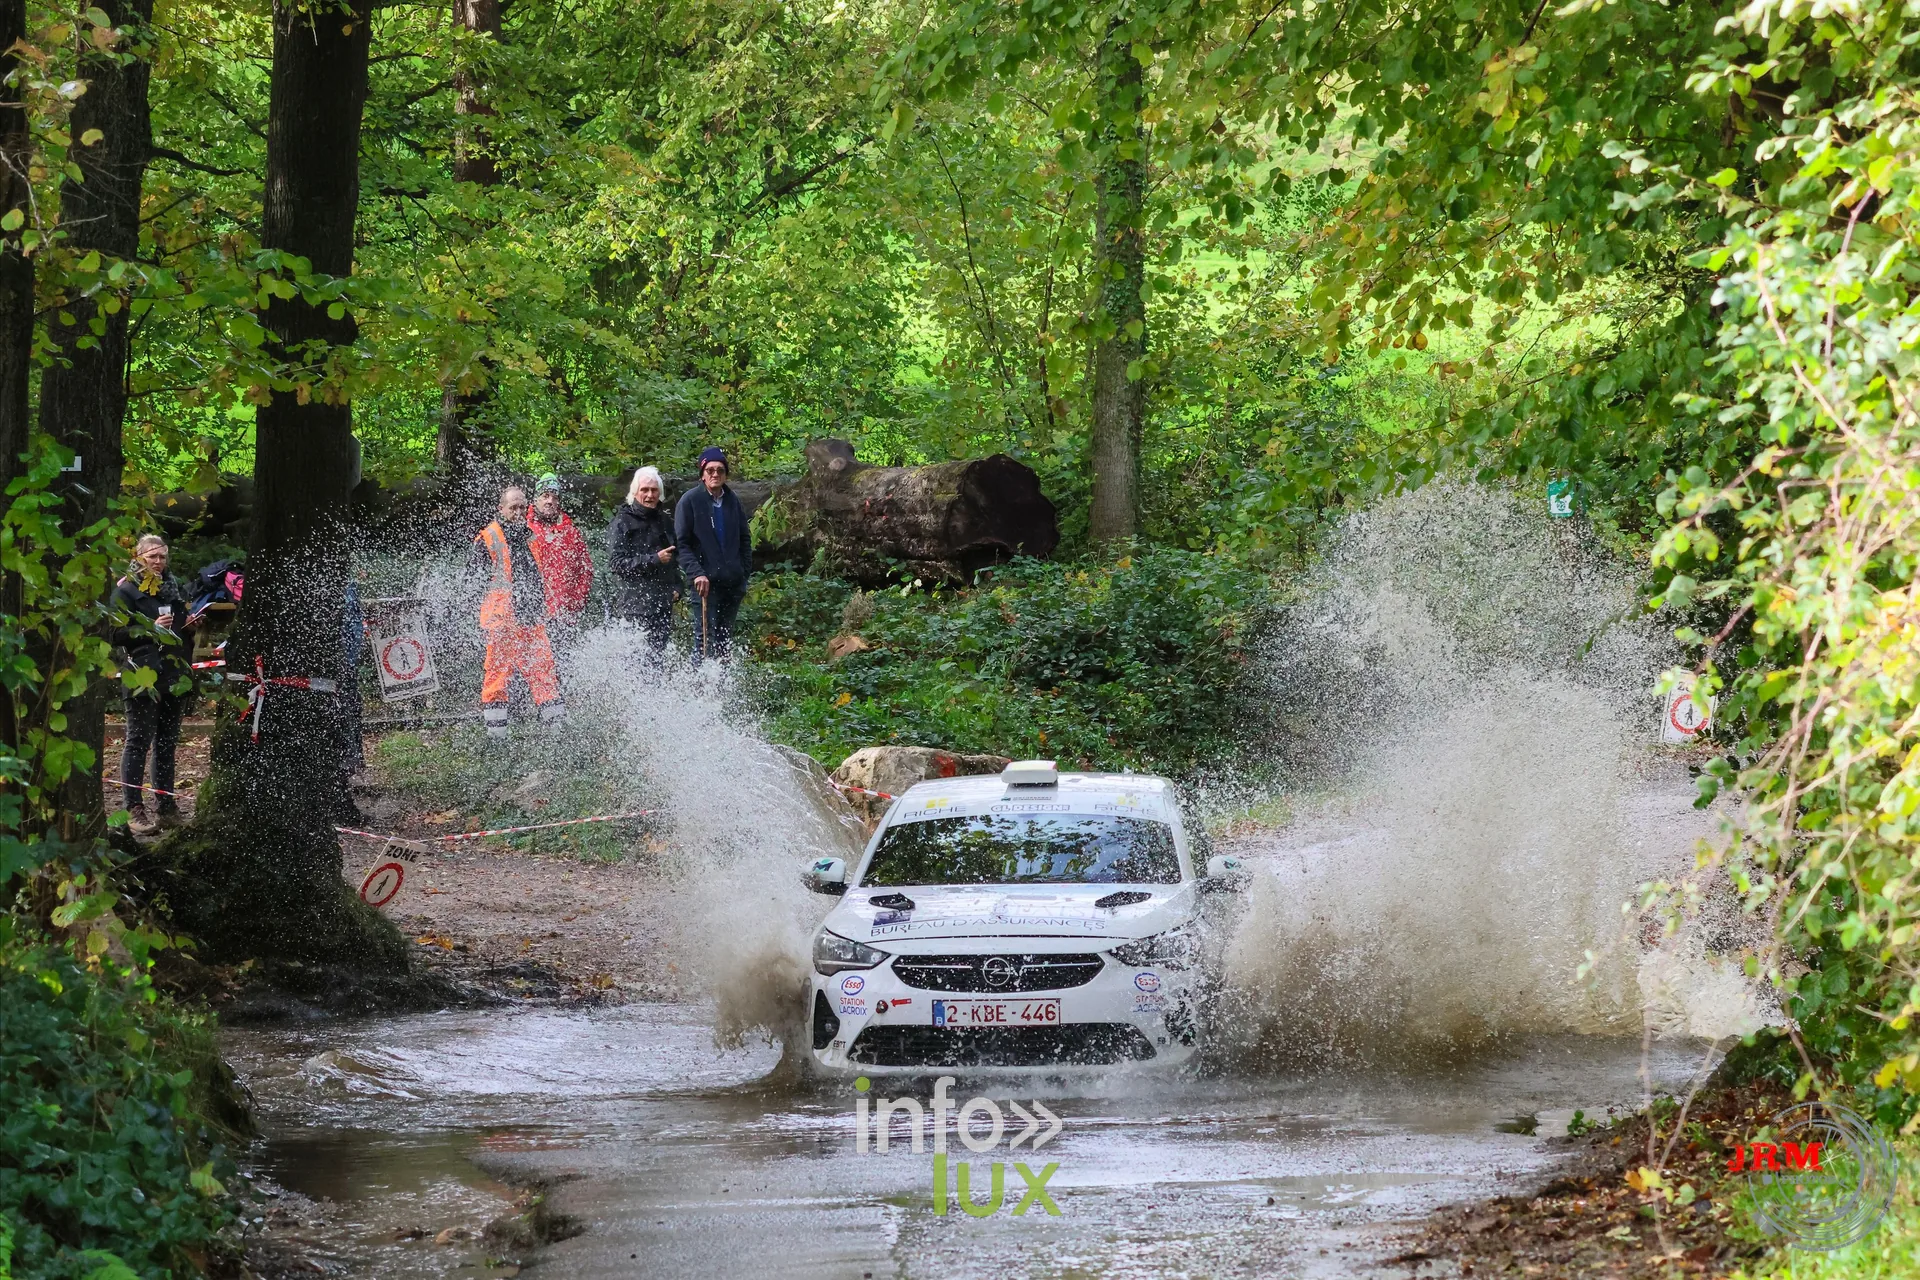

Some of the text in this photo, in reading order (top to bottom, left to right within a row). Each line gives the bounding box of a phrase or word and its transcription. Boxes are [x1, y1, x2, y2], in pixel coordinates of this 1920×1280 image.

[385, 845, 420, 863] ZONE
[871, 916, 1106, 937] BUREAU D'ASSURANCES
[840, 997, 865, 1006] STATION
[839, 1006, 867, 1016] LACROIX
[936, 1017, 943, 1025] B
